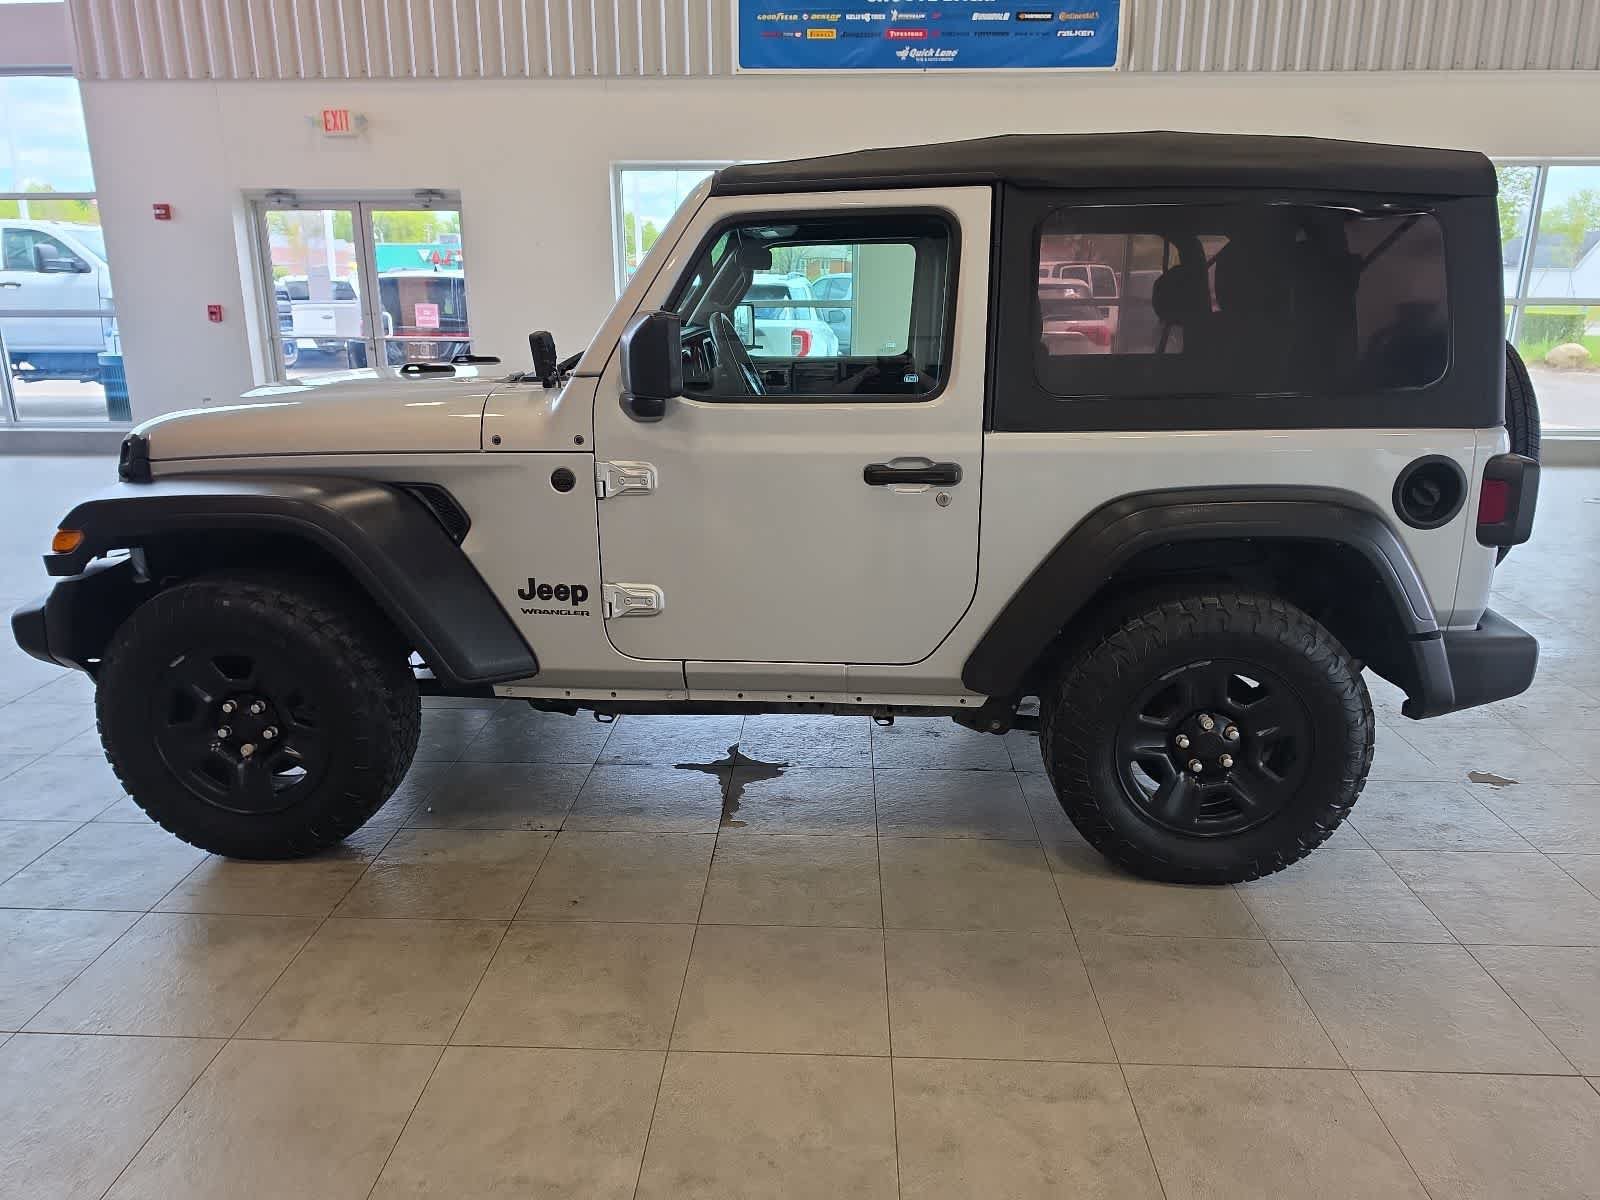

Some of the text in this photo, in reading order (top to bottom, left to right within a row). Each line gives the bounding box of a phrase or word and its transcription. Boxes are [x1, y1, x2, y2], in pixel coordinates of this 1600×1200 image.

[757, 12, 798, 21] GOODYEAR
[810, 13, 841, 22] DUNLOP
[909, 48, 959, 57] Quick Lane
[323, 110, 350, 131] EXIT
[517, 577, 589, 606] Jeep
[520, 607, 590, 617] WRANGLER
